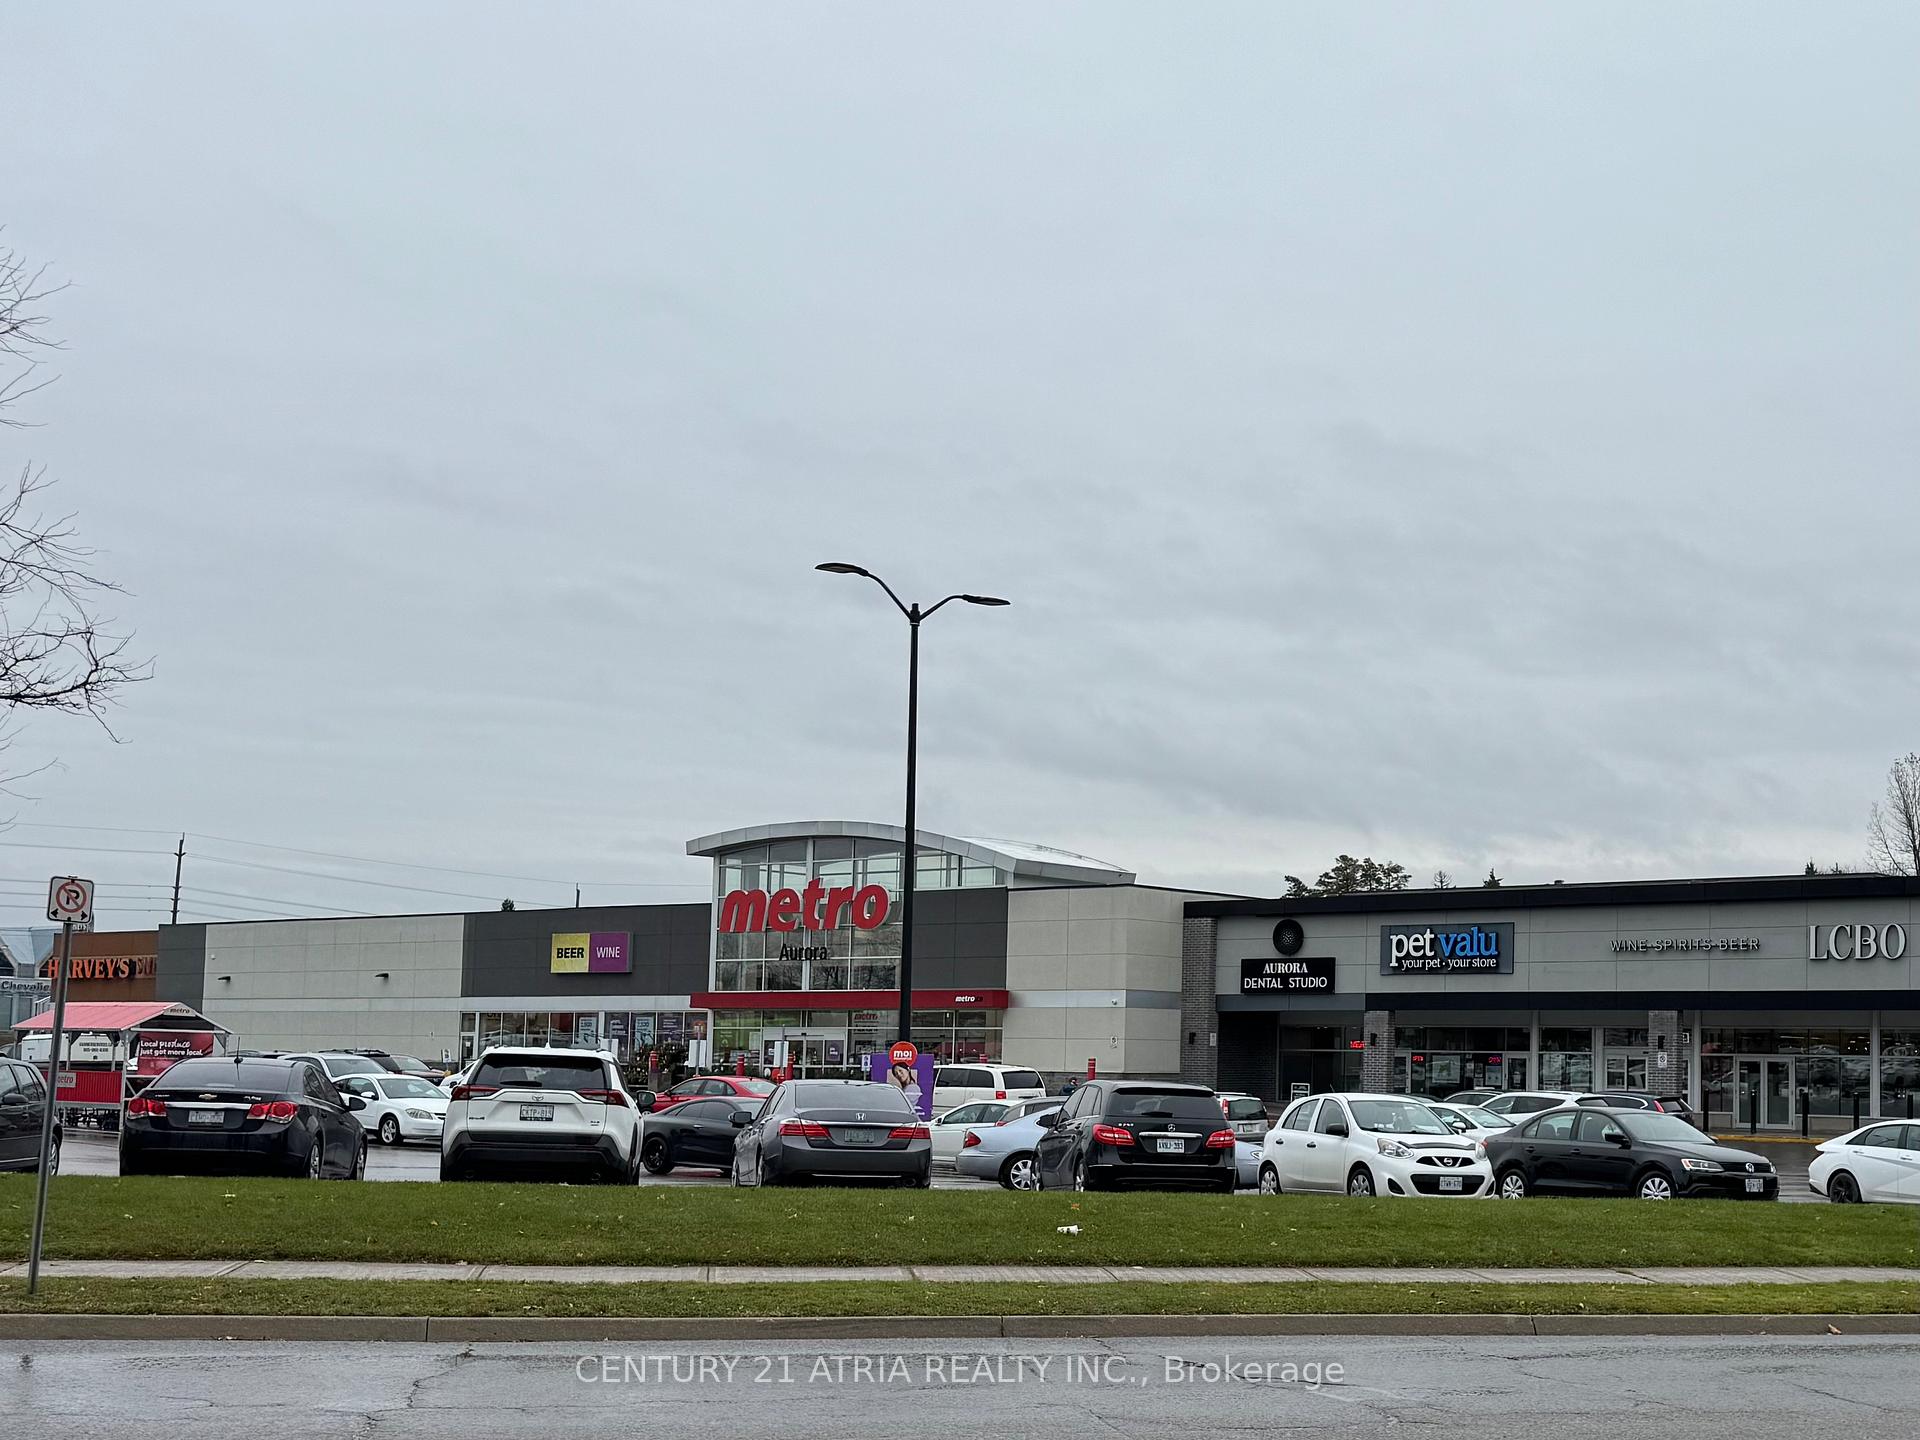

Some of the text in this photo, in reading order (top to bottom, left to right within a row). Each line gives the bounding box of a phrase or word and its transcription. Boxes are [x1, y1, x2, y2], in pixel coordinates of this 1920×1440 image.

[719, 877, 891, 933] metro
[1389, 926, 1499, 967] pet valu
[1610, 937, 1760, 952] WINE SPIRITS BEER
[1808, 923, 1907, 961] LCBO
[556, 947, 585, 959] BEER
[596, 946, 621, 958] WINE
[779, 943, 829, 962] Aurora
[47, 957, 131, 979] HRVEY'S
[1263, 962, 1309, 974] AURORA
[1401, 958, 1497, 971] your pet your store
[1244, 976, 1328, 989] DENTAL STUDIO
[140, 1048, 153, 1056] just
